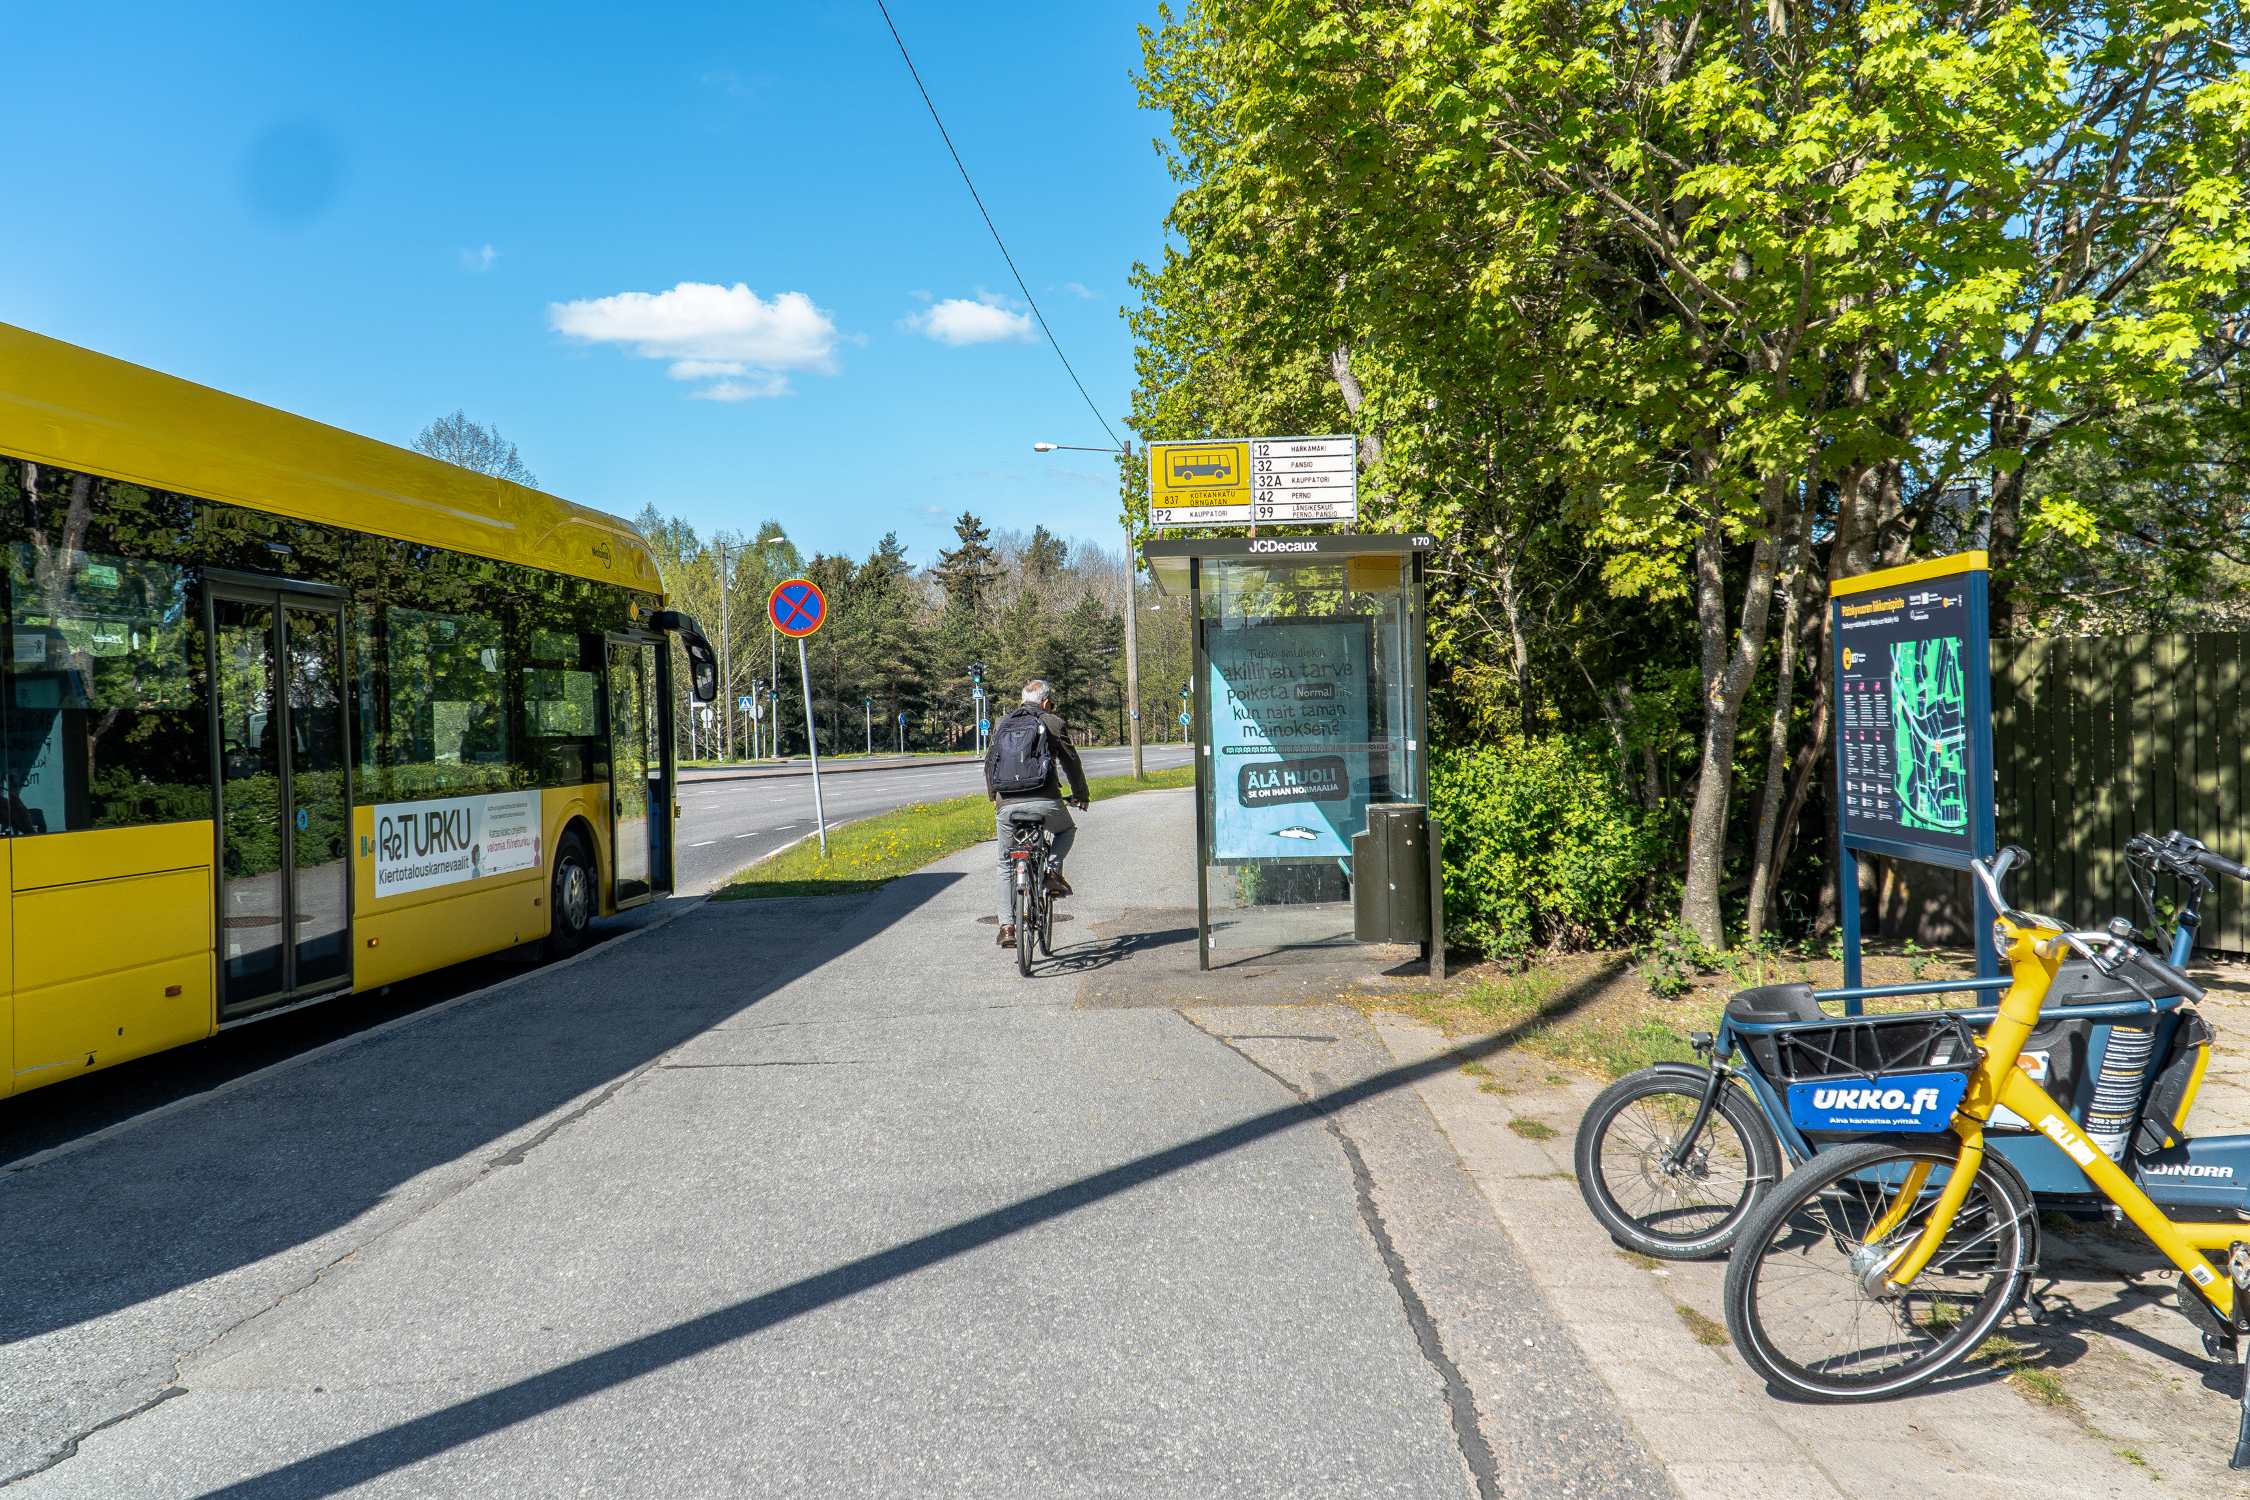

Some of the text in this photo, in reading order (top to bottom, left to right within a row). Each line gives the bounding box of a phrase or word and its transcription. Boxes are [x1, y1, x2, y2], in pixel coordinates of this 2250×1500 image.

[1258, 445, 1270, 456] 12
[1258, 460, 1272, 471] 32
[1259, 476, 1330, 487] 32A KAUPPATORI
[1164, 496, 1179, 505] 837
[1190, 491, 1236, 499] KOTKANKATU
[1259, 491, 1273, 502] 42
[1156, 510, 1172, 521] P2
[1259, 507, 1273, 518] 99
[1249, 540, 1318, 553] JCDecaux
[1411, 537, 1430, 546] 170
[1223, 662, 1354, 681] äkillinen tarve
[1227, 683, 1290, 705] poiketa
[1233, 703, 1346, 720] kun näit tämän
[1243, 719, 1340, 737] mainoksen?
[1247, 768, 1336, 789] ÄLÄ HUOLI
[1248, 784, 1339, 798] SE ON IHAN NORMAALIA
[379, 855, 470, 885] Kiertotalouskarnevaalit
[1813, 1088, 1940, 1115] UKKO.fi
[1849, 1117, 1891, 1125] kannattaa
